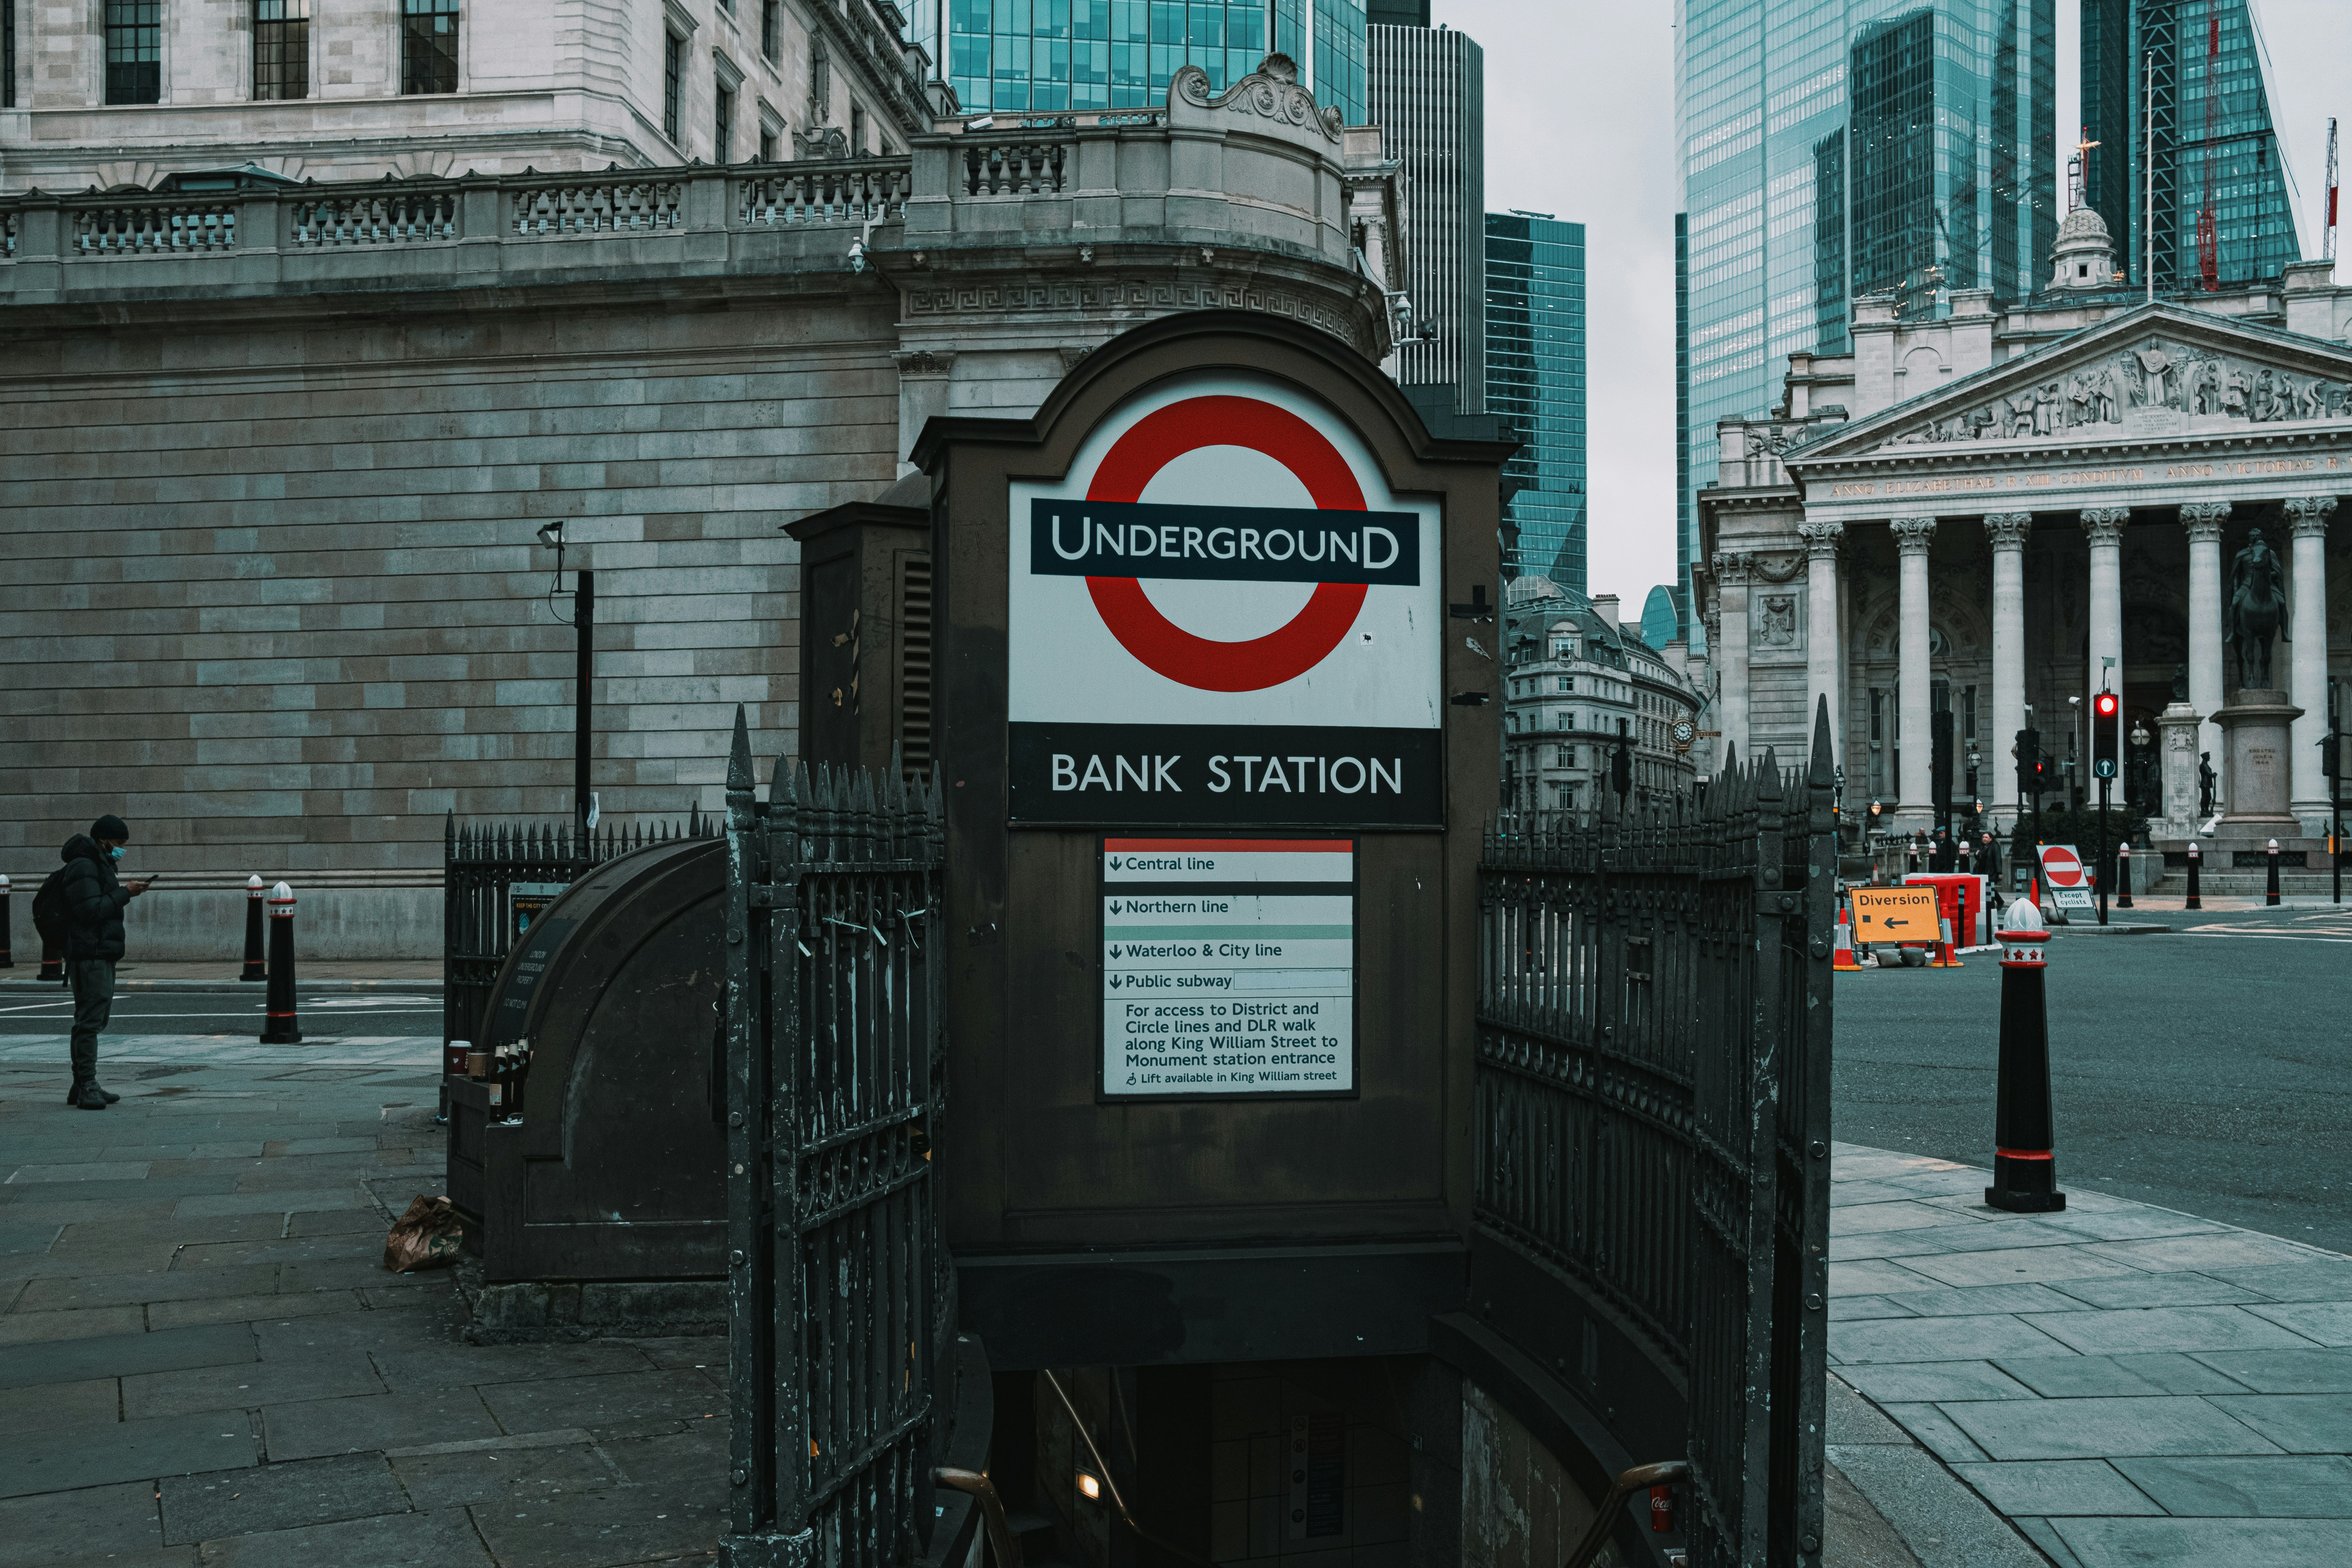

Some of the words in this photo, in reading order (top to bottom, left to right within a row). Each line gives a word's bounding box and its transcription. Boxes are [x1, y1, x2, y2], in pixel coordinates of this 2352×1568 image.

[1831, 484, 1874, 497] ANNO
[1885, 476, 1995, 493] ELIZABETHAE
[2007, 476, 2016, 487] R
[2059, 469, 2143, 484] CONDITVM
[2164, 464, 2213, 478] ANNO
[2224, 458, 2316, 475] VICTORIAE
[2327, 457, 2338, 469] R
[1052, 516, 1399, 568] UNDERGROUND
[1053, 754, 1182, 792] BANK
[1208, 756, 1401, 793] STATION
[1126, 858, 1182, 870] Central
[1188, 858, 1214, 870] line
[1127, 900, 1196, 913] Northern
[1202, 900, 1228, 912] line
[1860, 894, 1929, 905] Diversion
[1126, 945, 1196, 957] Waterloo
[1203, 944, 1213, 956] &
[1219, 944, 1250, 959] City
[1256, 944, 1282, 956] line
[1127, 975, 1171, 987] Public
[1177, 975, 1231, 989] subway
[1127, 1004, 1149, 1017] For
[1155, 1007, 1204, 1016] access
[1210, 1005, 1226, 1015] to
[1233, 1003, 1287, 1015] District
[1293, 1002, 1318, 1014] and
[1126, 1021, 1169, 1033] Circle
[1175, 1021, 1209, 1033] lines
[1215, 1020, 1241, 1032] and
[1248, 1019, 1277, 1031] DLR
[1283, 1019, 1315, 1031] walk
[1125, 1038, 1165, 1052] along
[1172, 1037, 1204, 1052] King
[1210, 1036, 1265, 1048] William
[1271, 1035, 1316, 1048] Street
[1322, 1036, 1338, 1047] to
[1127, 1055, 1207, 1067] Monument
[1213, 1053, 1266, 1065] station
[1271, 1053, 1335, 1064] entrance
[1142, 1073, 1161, 1083] Lift
[1165, 1073, 1213, 1083] available
[1217, 1073, 1226, 1081] in
[1231, 1072, 1254, 1083] King
[1259, 1072, 1300, 1081] William
[1304, 1071, 1337, 1080] street
